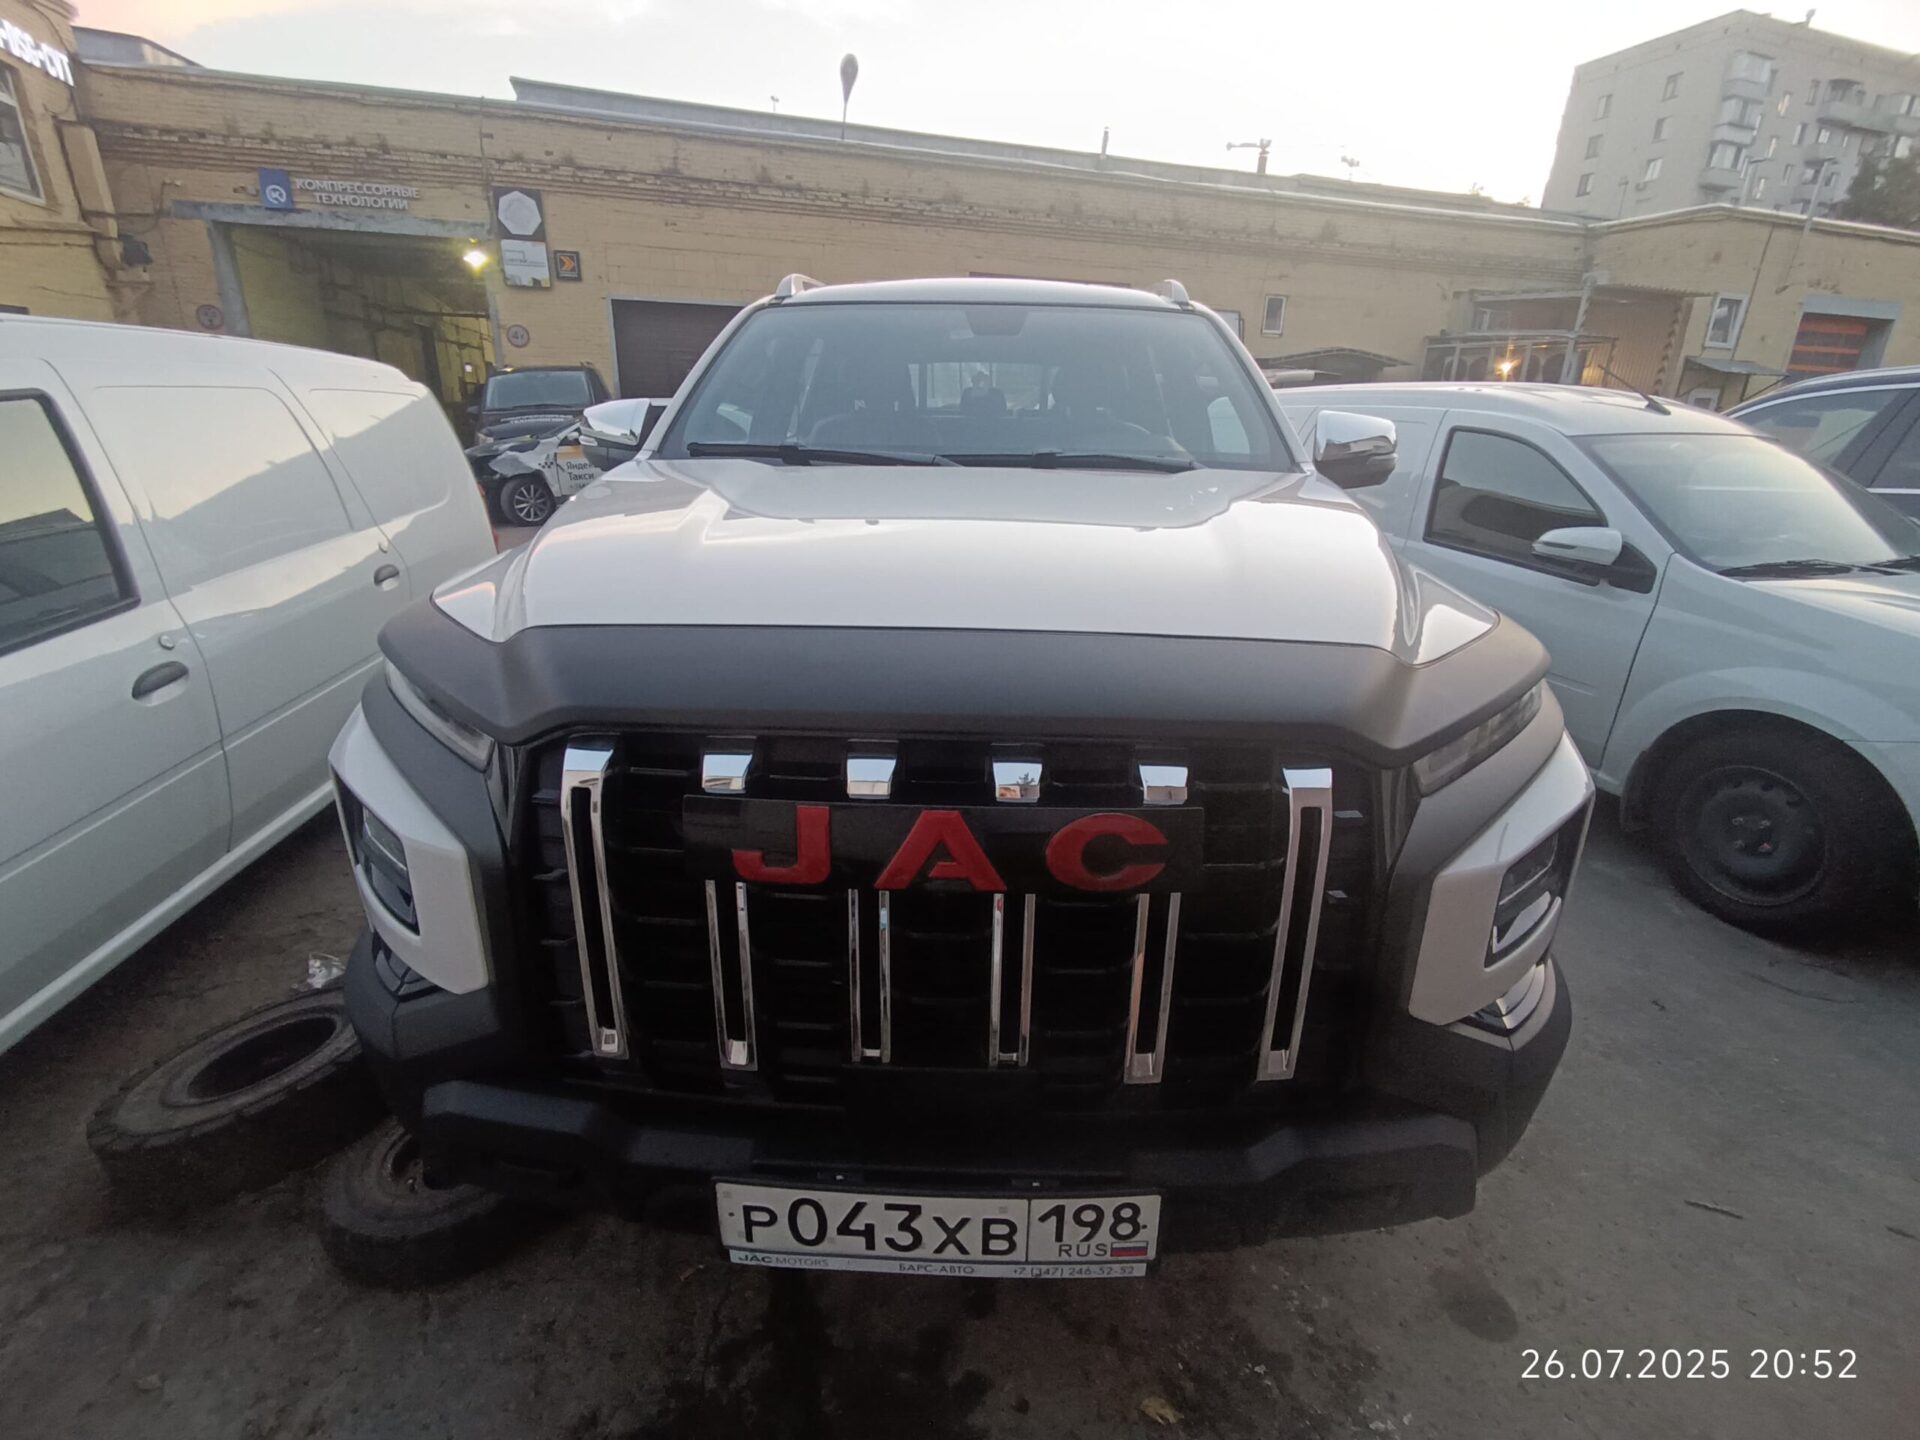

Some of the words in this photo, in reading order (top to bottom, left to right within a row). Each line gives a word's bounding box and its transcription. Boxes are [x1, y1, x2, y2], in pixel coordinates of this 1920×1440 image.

[295, 178, 421, 199] КОМПРЕССОРНЫЕ
[315, 192, 409, 210] ТЕХНОЛОГИИ
[565, 461, 593, 471] Янде
[568, 472, 595, 481] Такси
[731, 804, 1169, 892] JAC
[1038, 1202, 1141, 1243] 198
[1058, 1243, 1108, 1258] RUS
[737, 1254, 773, 1264] JAC
[775, 1257, 830, 1268] MOTORS
[898, 1263, 975, 1274] БАРС-АВТО
